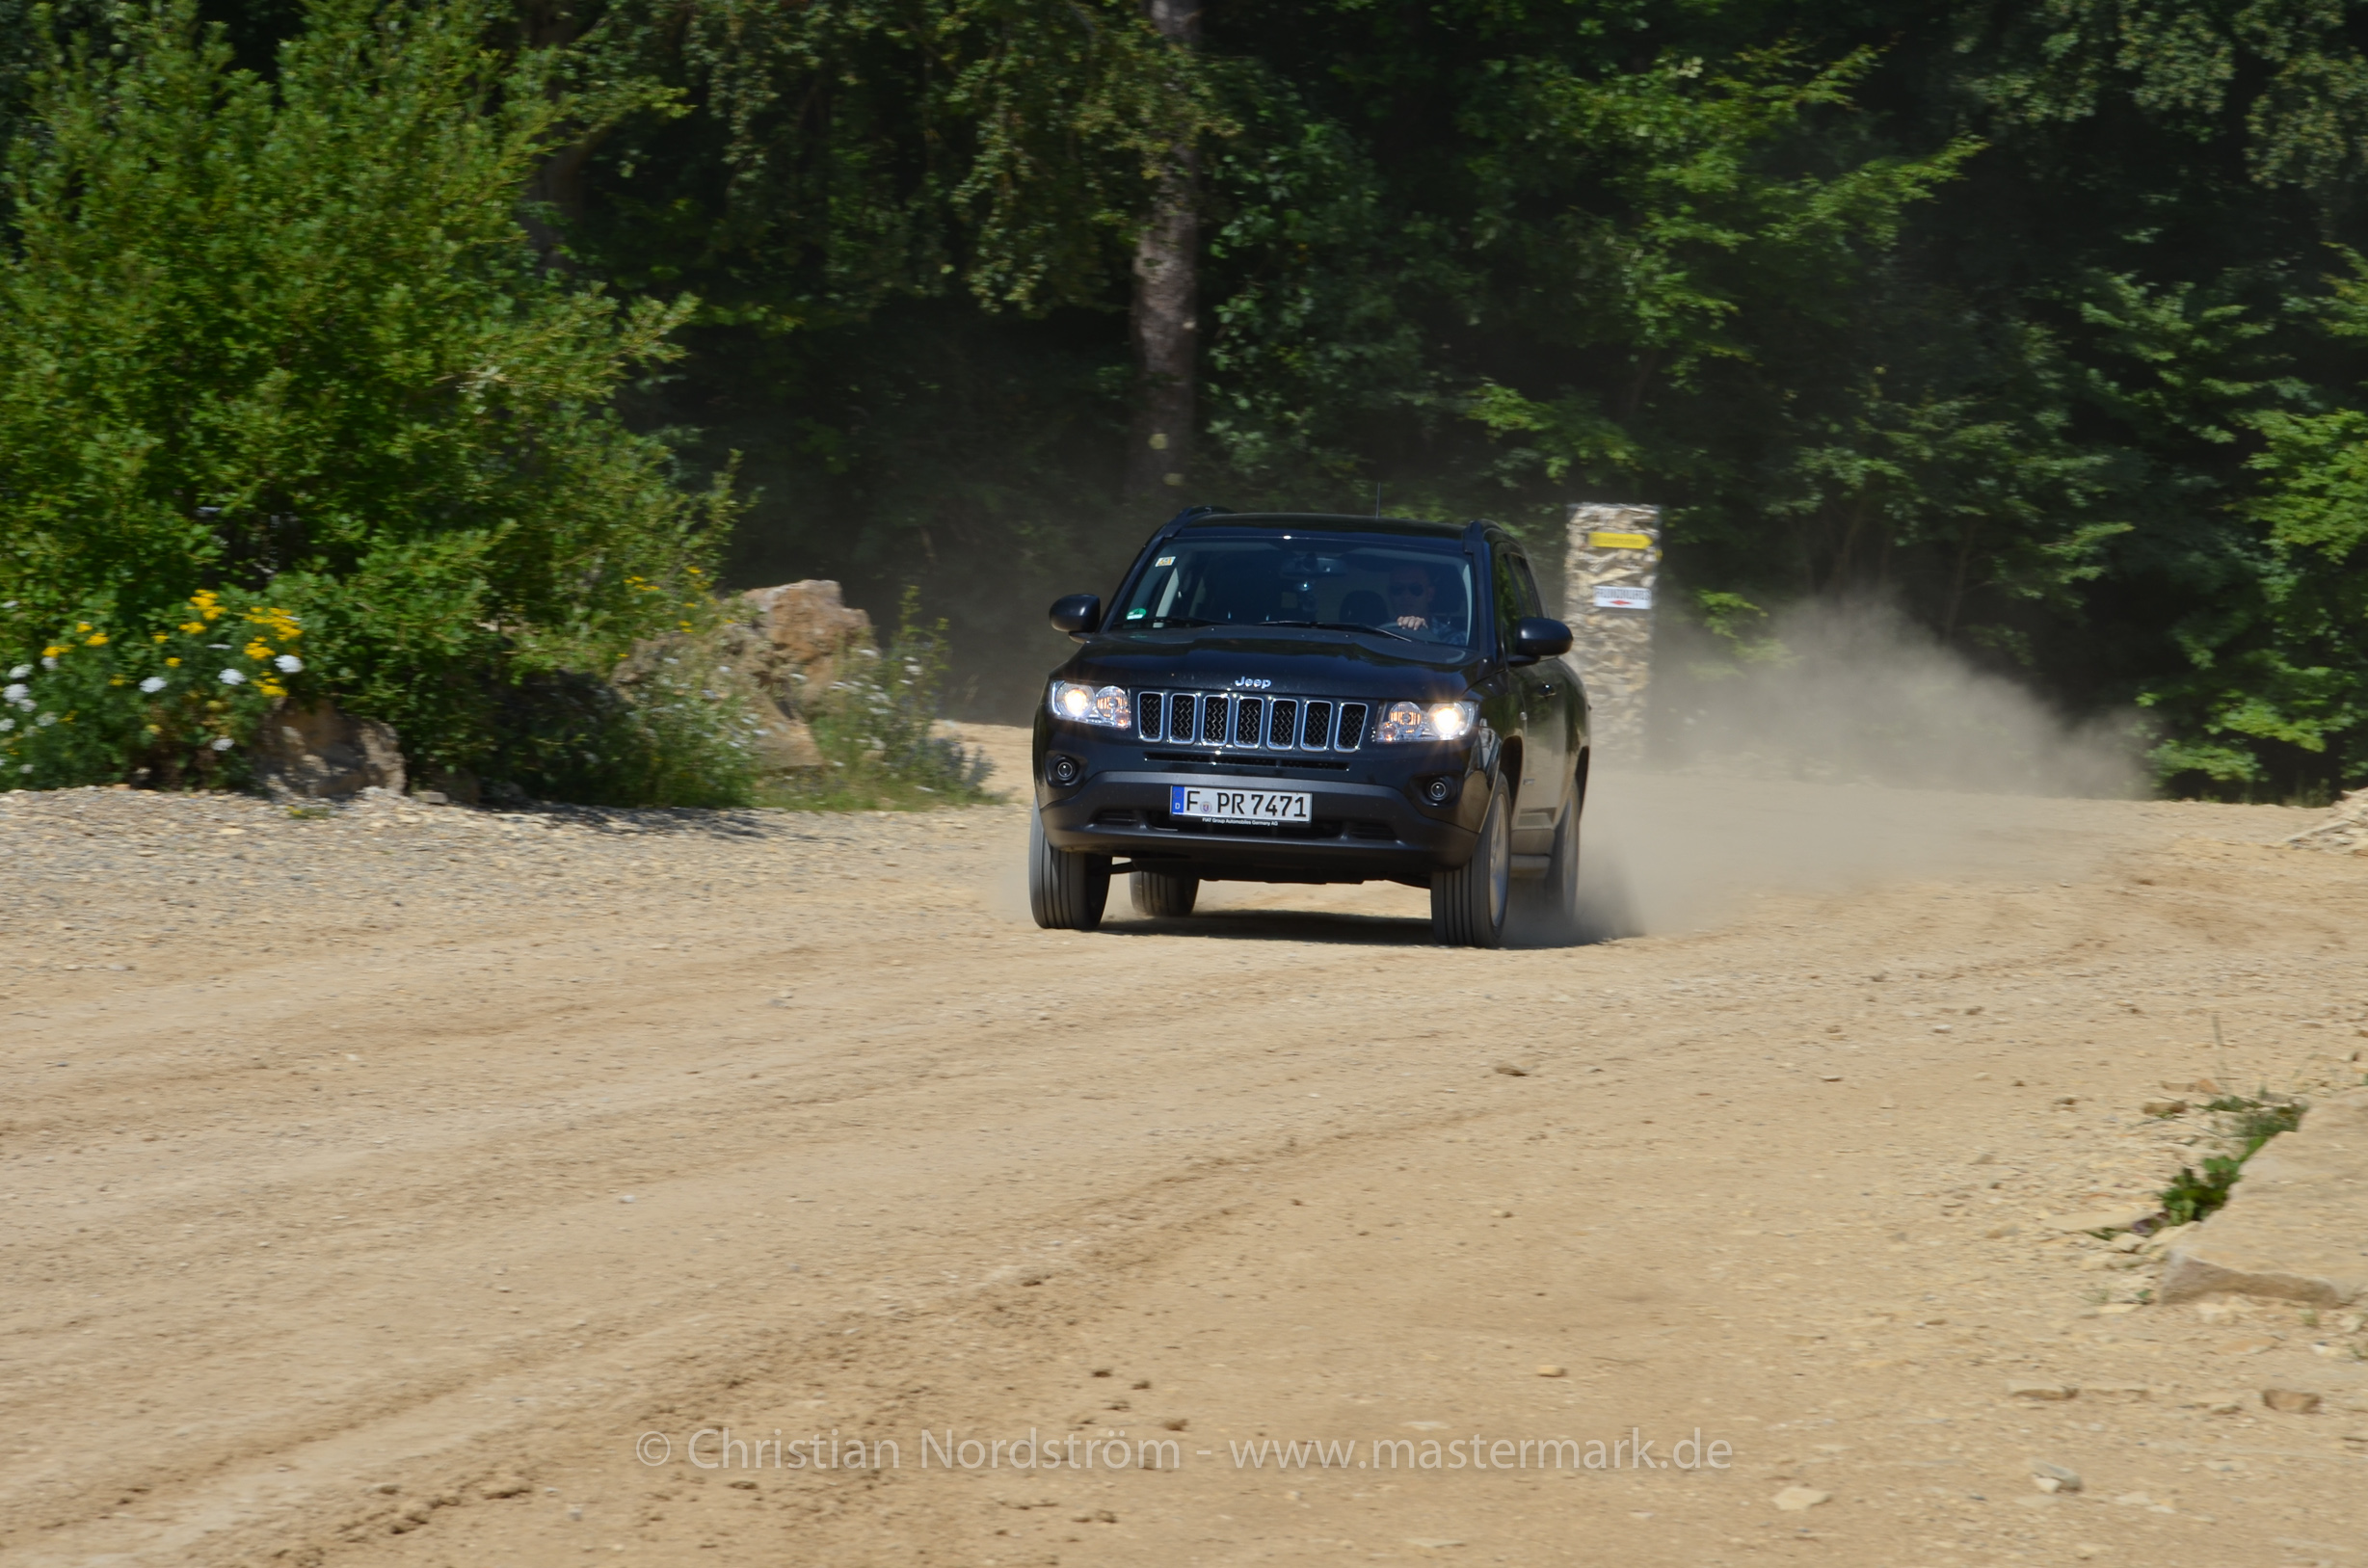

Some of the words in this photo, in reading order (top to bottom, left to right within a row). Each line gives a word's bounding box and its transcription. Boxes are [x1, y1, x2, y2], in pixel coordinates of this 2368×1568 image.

[1235, 676, 1272, 690] Jeep
[1186, 790, 1201, 811] F
[1217, 792, 1245, 814] PR
[1251, 794, 1307, 818] 7471
